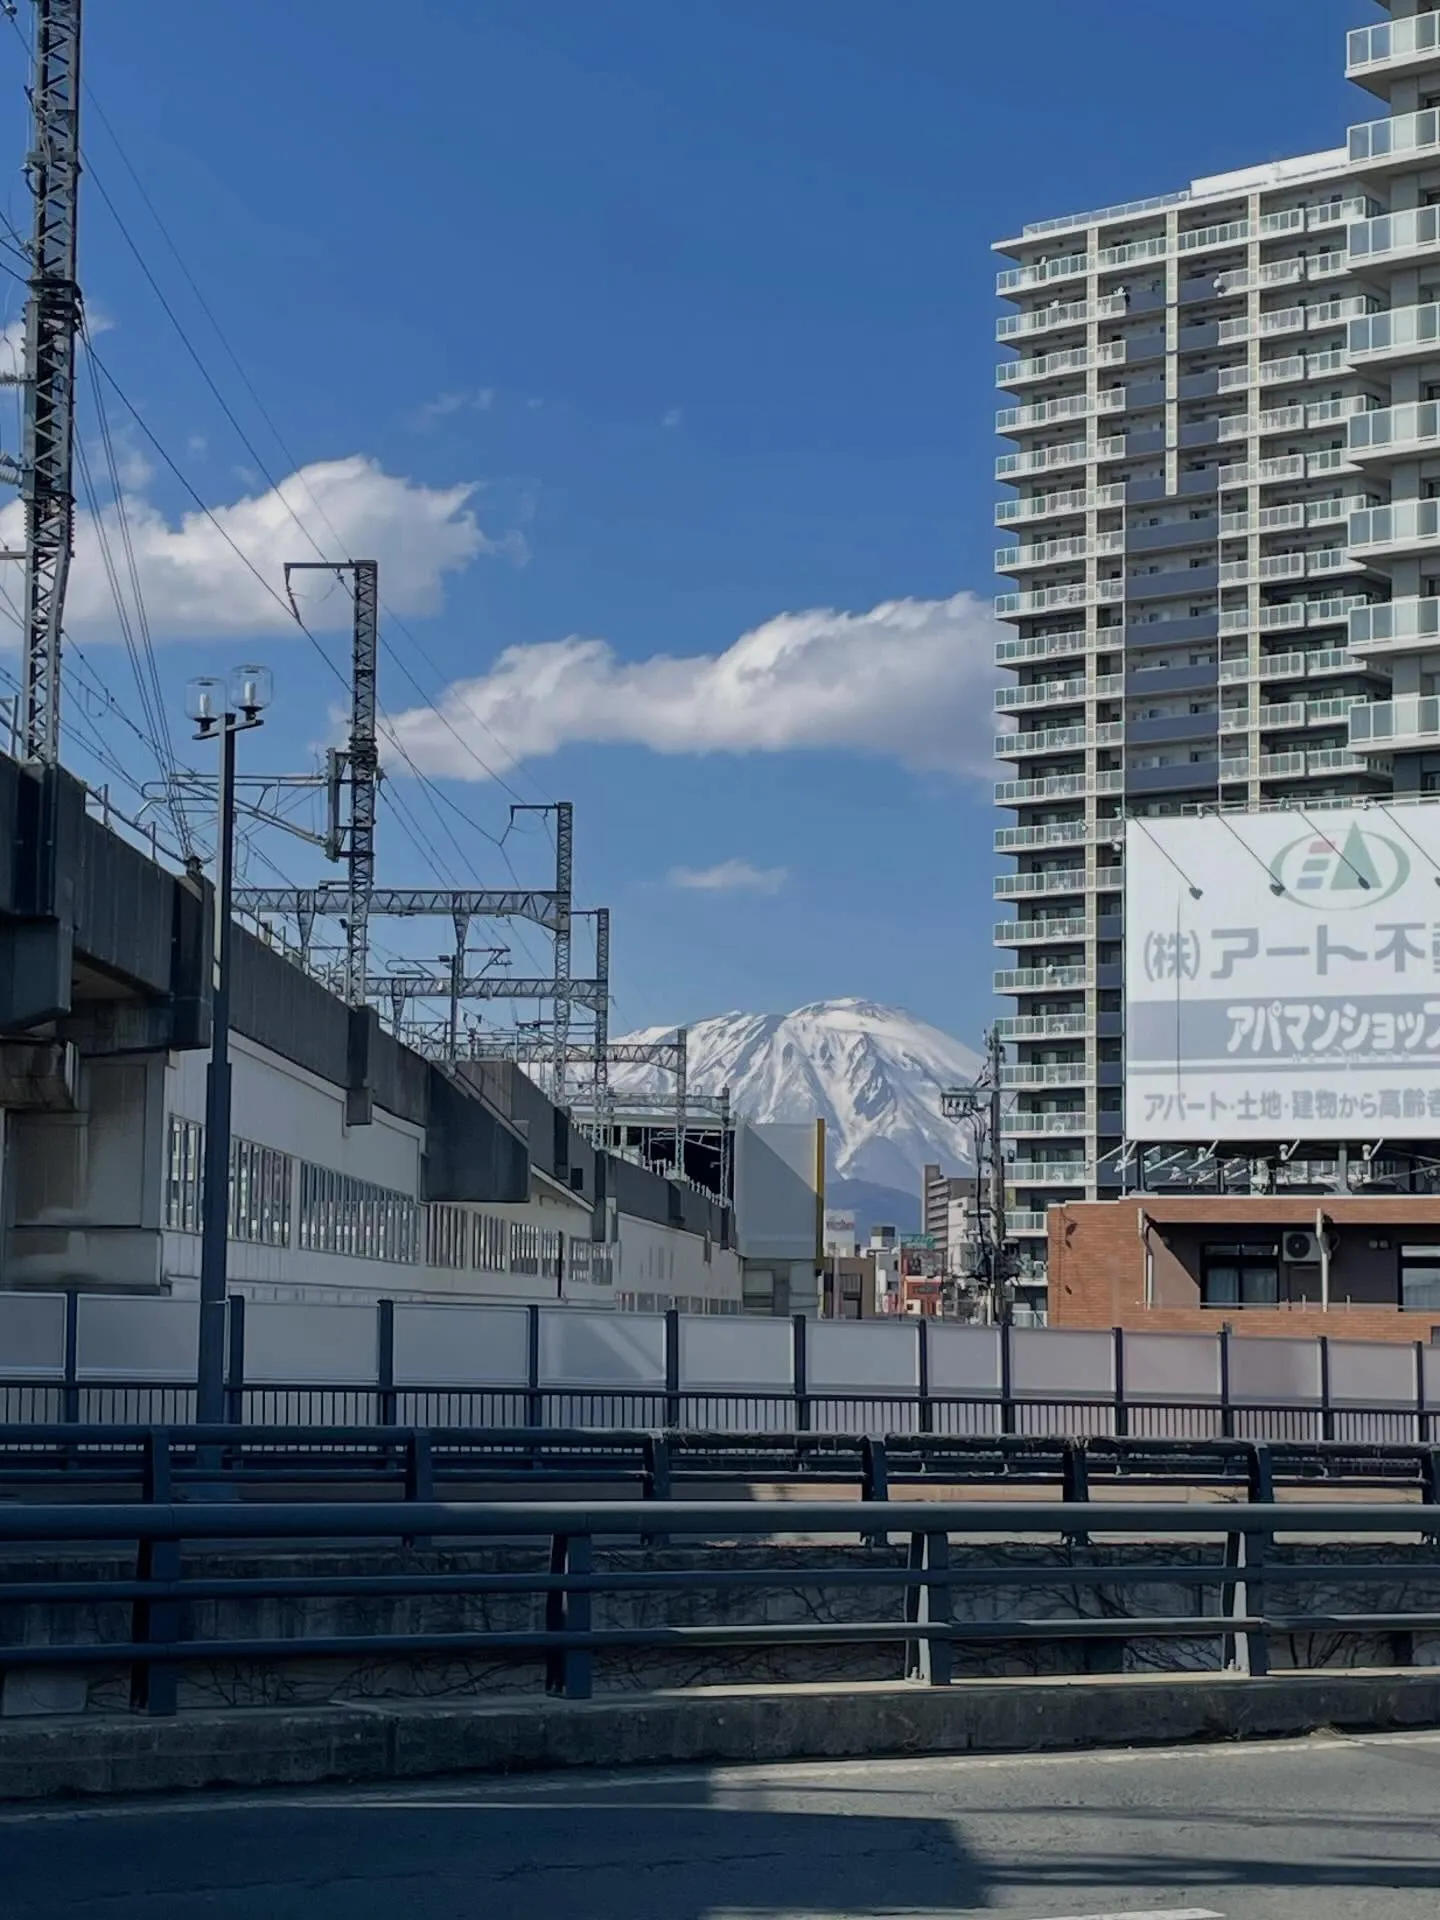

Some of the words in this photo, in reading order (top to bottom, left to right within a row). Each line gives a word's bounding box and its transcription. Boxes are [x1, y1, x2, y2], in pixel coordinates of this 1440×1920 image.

[1144, 922, 1440, 981] (株)アート不
